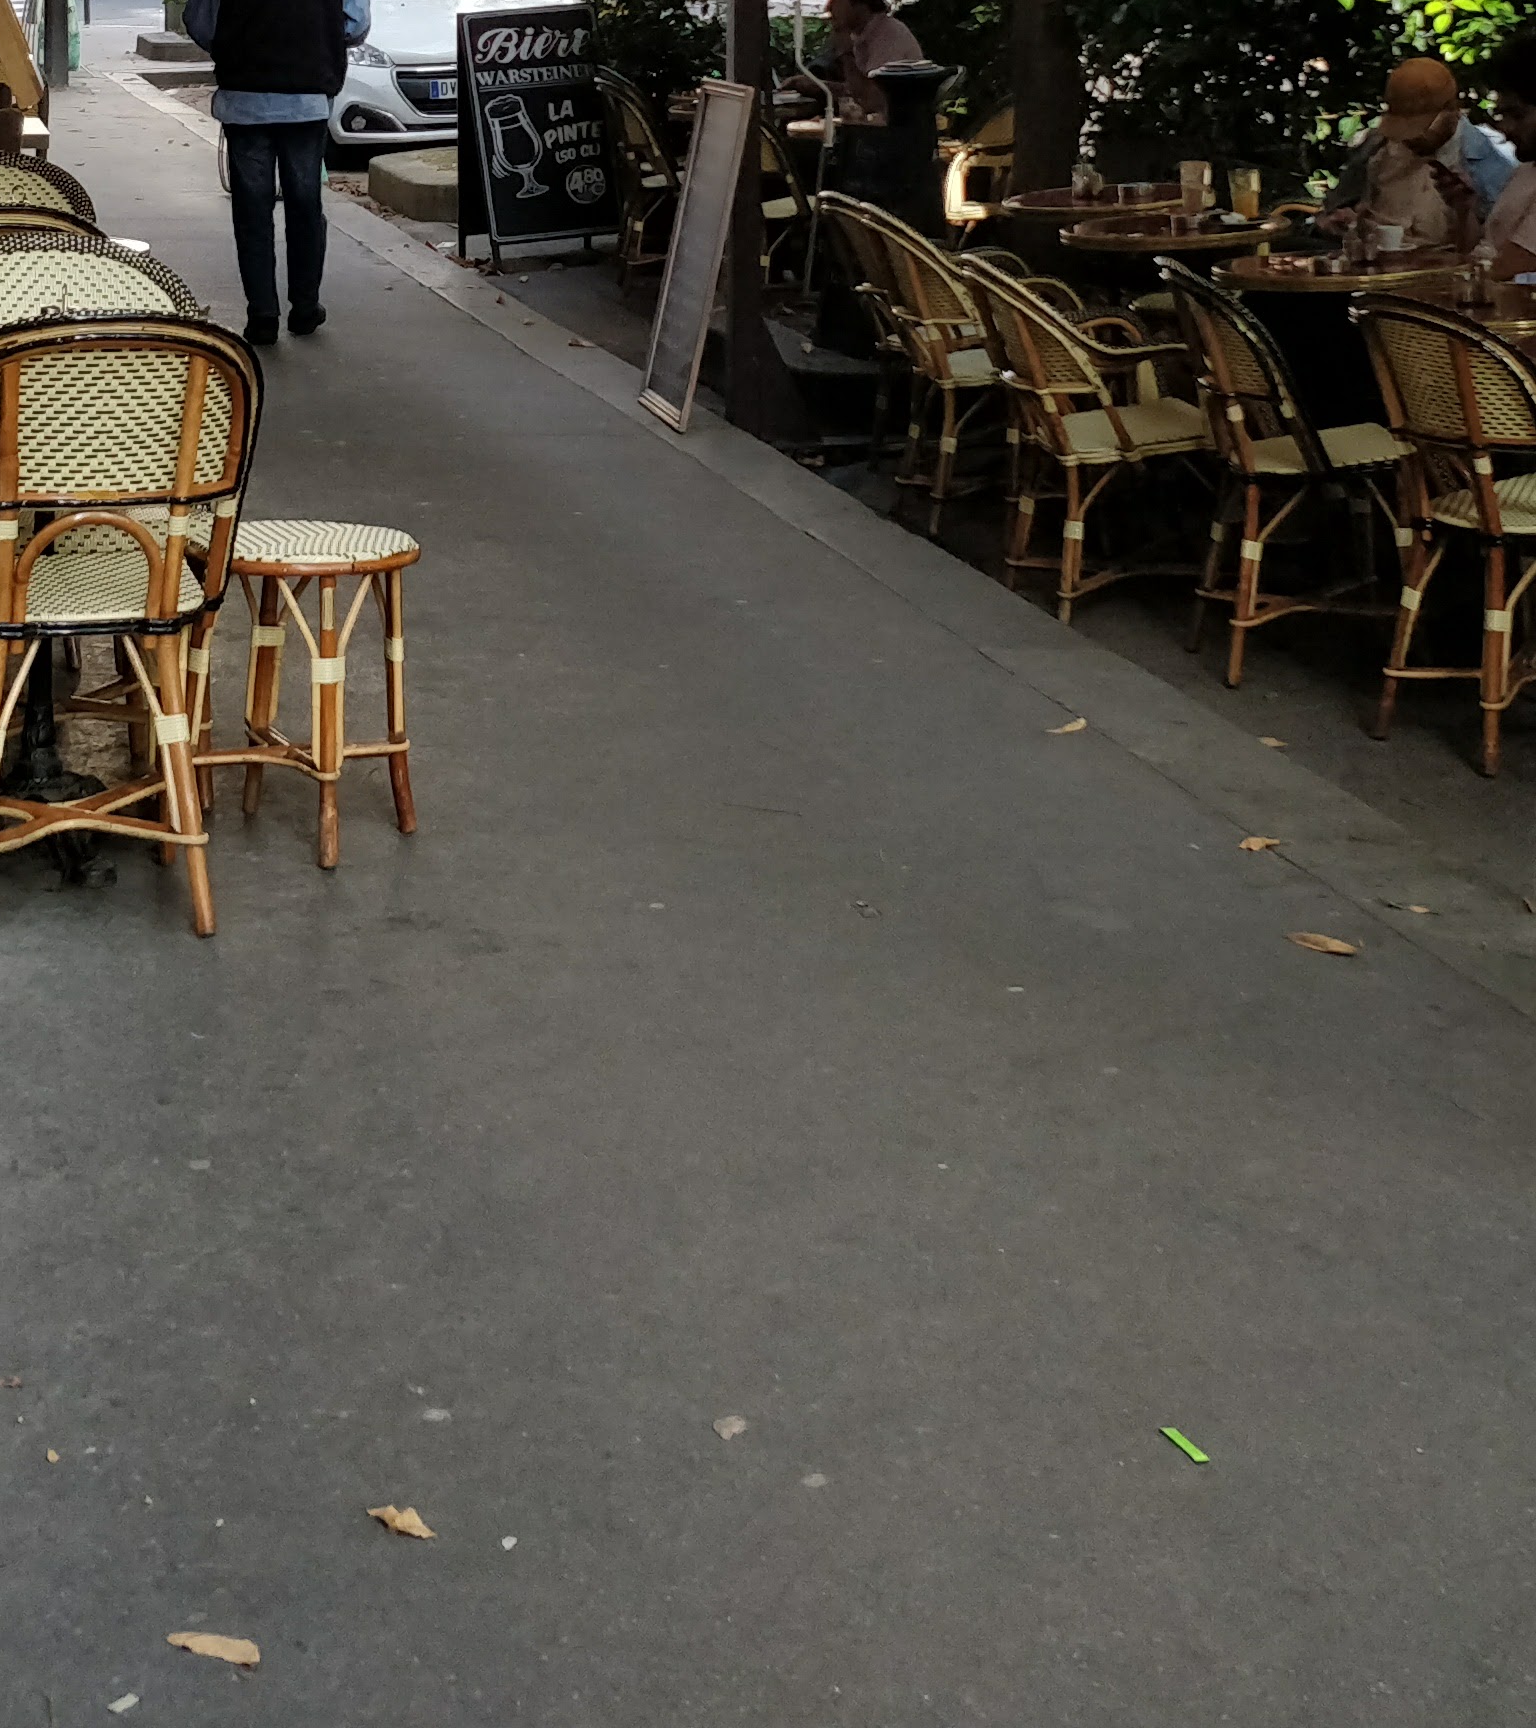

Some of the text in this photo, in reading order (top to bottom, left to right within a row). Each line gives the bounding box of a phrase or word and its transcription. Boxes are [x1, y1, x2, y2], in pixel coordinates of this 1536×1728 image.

[474, 25, 591, 64] Bière
[547, 99, 574, 122] LA
[543, 120, 603, 149] PINTE
